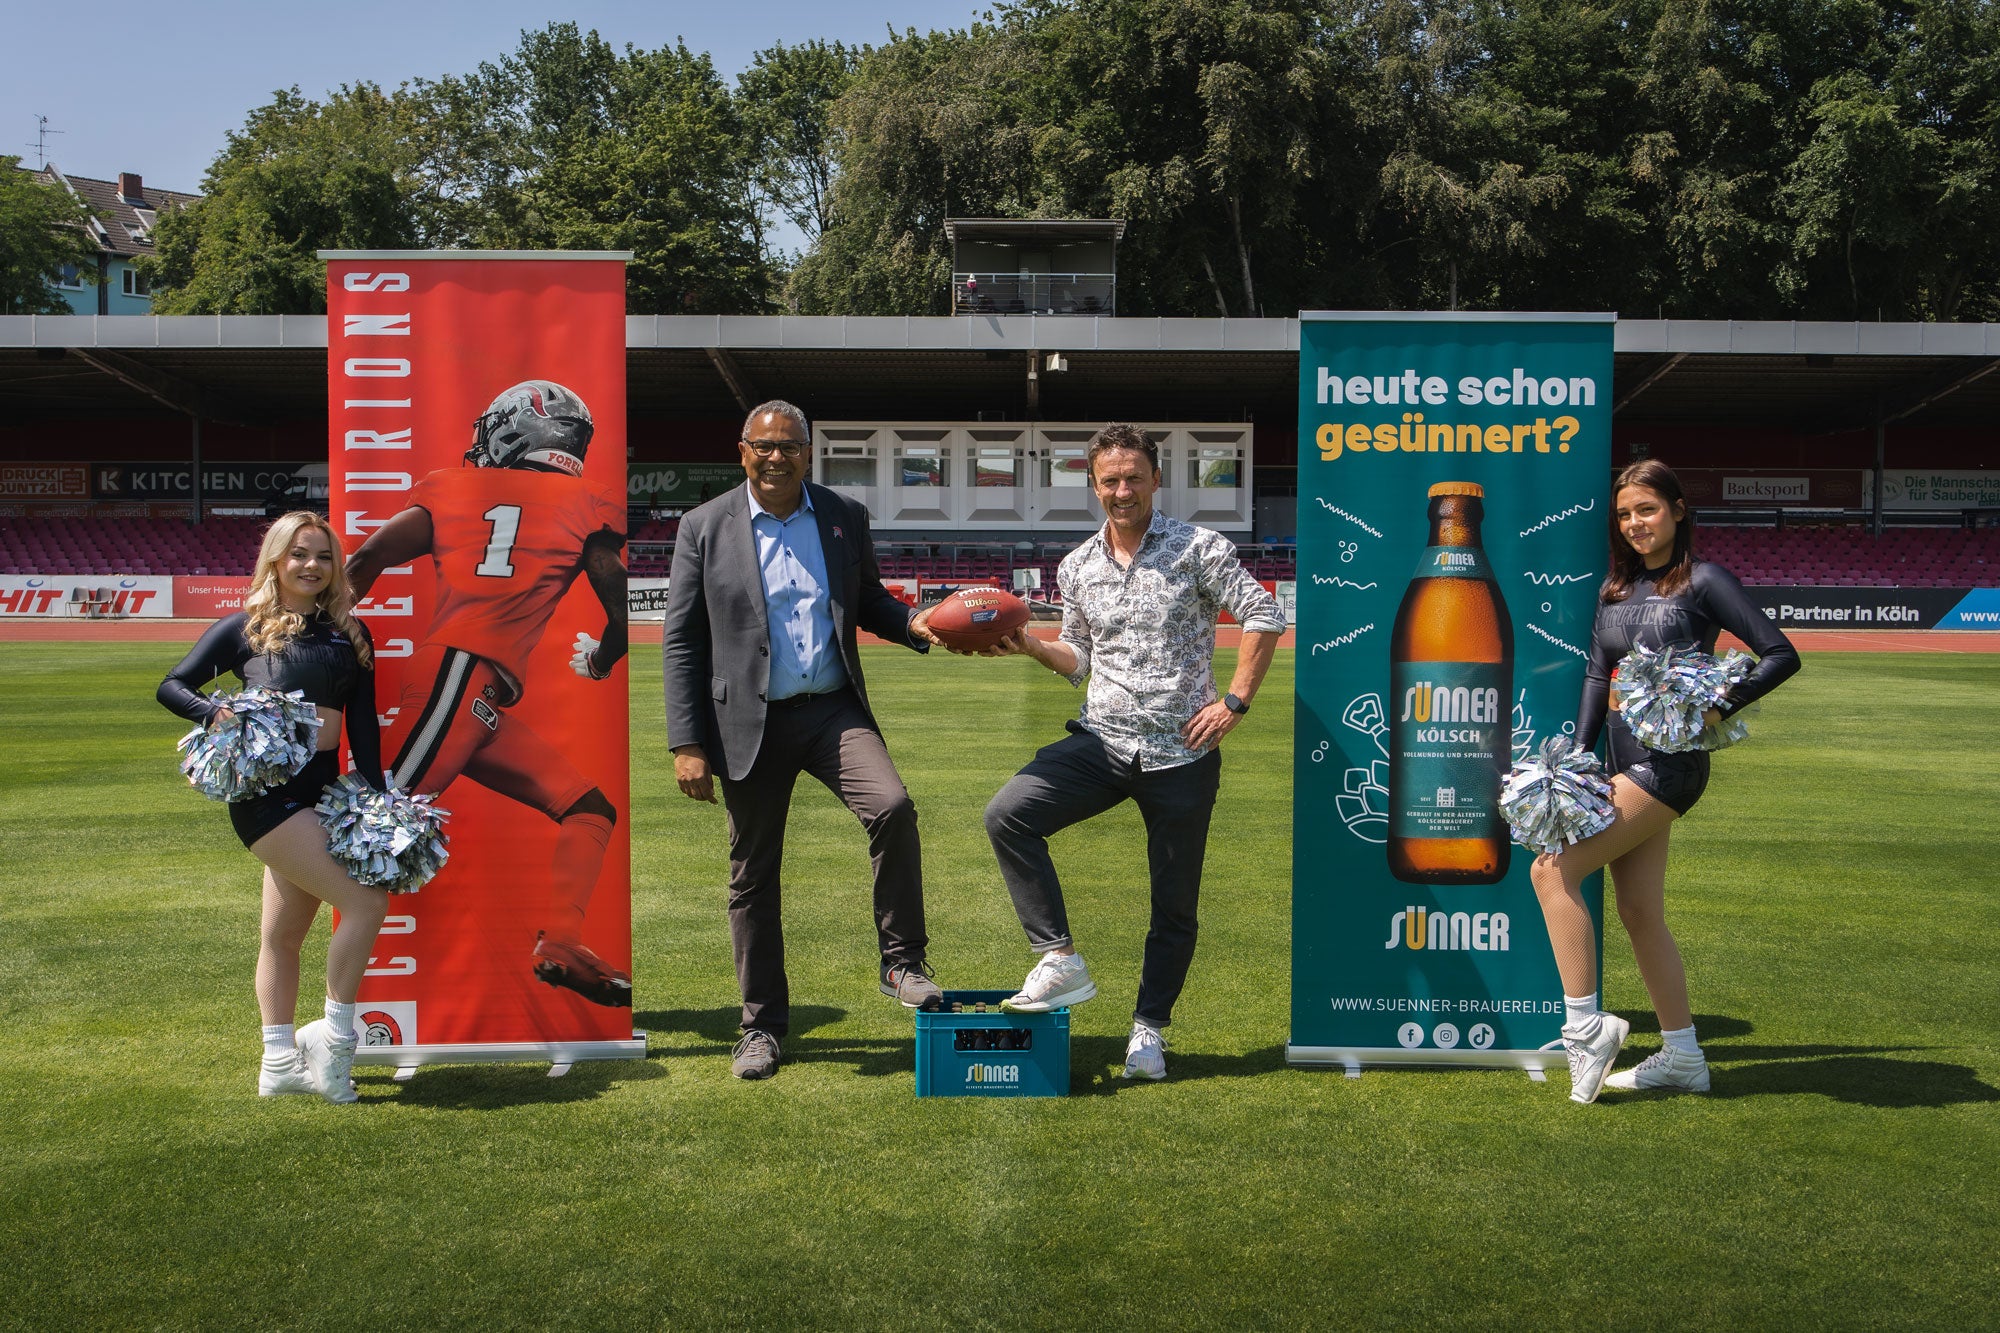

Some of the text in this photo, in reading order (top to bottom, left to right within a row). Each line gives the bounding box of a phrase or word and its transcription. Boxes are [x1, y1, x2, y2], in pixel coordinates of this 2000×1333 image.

[1316, 366, 1596, 406] heute schon
[1315, 412, 1581, 462] gesünnert?
[3, 469, 56, 480] DRUCK
[1904, 475, 1926, 488] Die
[1727, 481, 1805, 499] Backsport
[1909, 489, 1928, 501] für
[187, 585, 211, 594] Unser
[213, 586, 232, 594] Herz
[645, 590, 660, 599] Tor
[0, 590, 63, 612] HIT
[631, 600, 651, 611] Welt
[964, 598, 999, 608] Wilson
[1780, 604, 1851, 621] Partner
[1855, 605, 1872, 621] in
[1876, 606, 1919, 622] Köln
[1401, 681, 1499, 724] SÜNNER
[1416, 727, 1481, 744] KÖLSCH
[1385, 905, 1510, 952] SÜNNER
[1331, 997, 1563, 1015] WWW.SUENNER-BRAUEREI.DE
[965, 1063, 1019, 1083] SÜNNER
